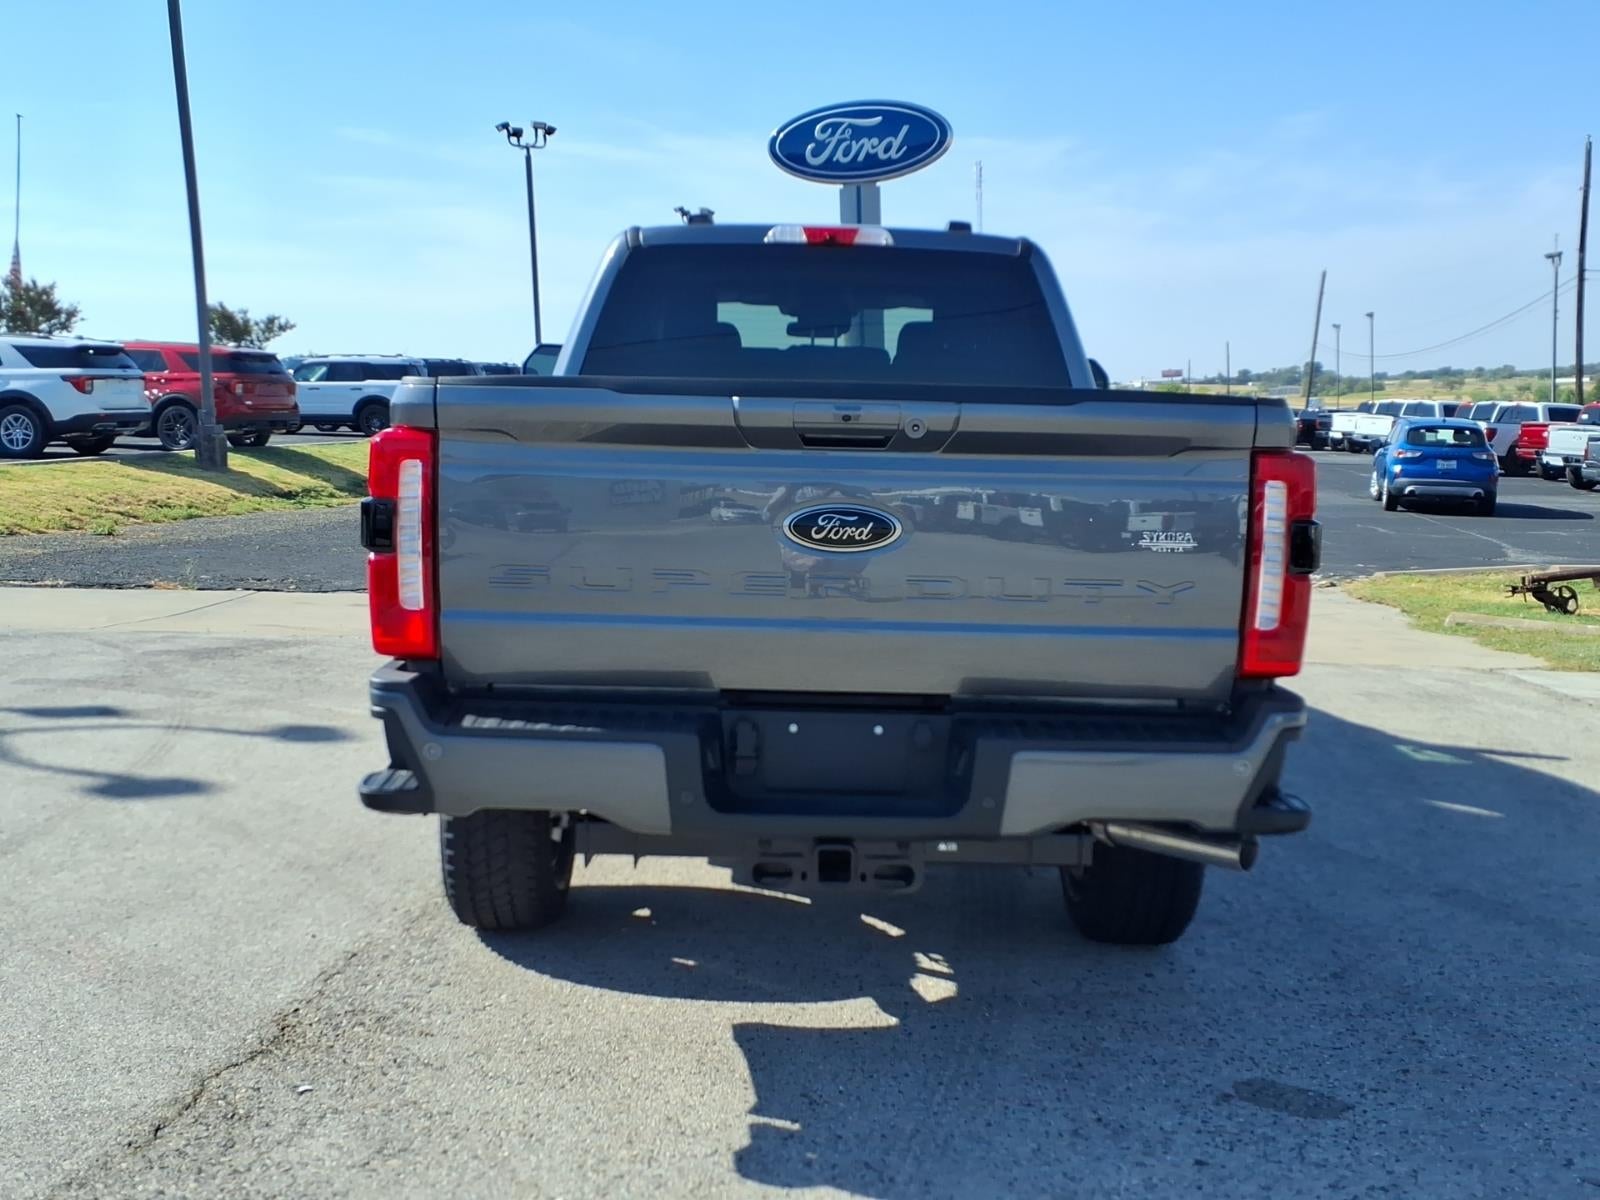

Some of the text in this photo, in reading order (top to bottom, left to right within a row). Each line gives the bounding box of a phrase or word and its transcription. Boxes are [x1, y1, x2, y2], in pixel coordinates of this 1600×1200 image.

[805, 116, 910, 166] Ford
[811, 513, 874, 540] Ford
[488, 563, 1196, 605] SUPER DUTY
